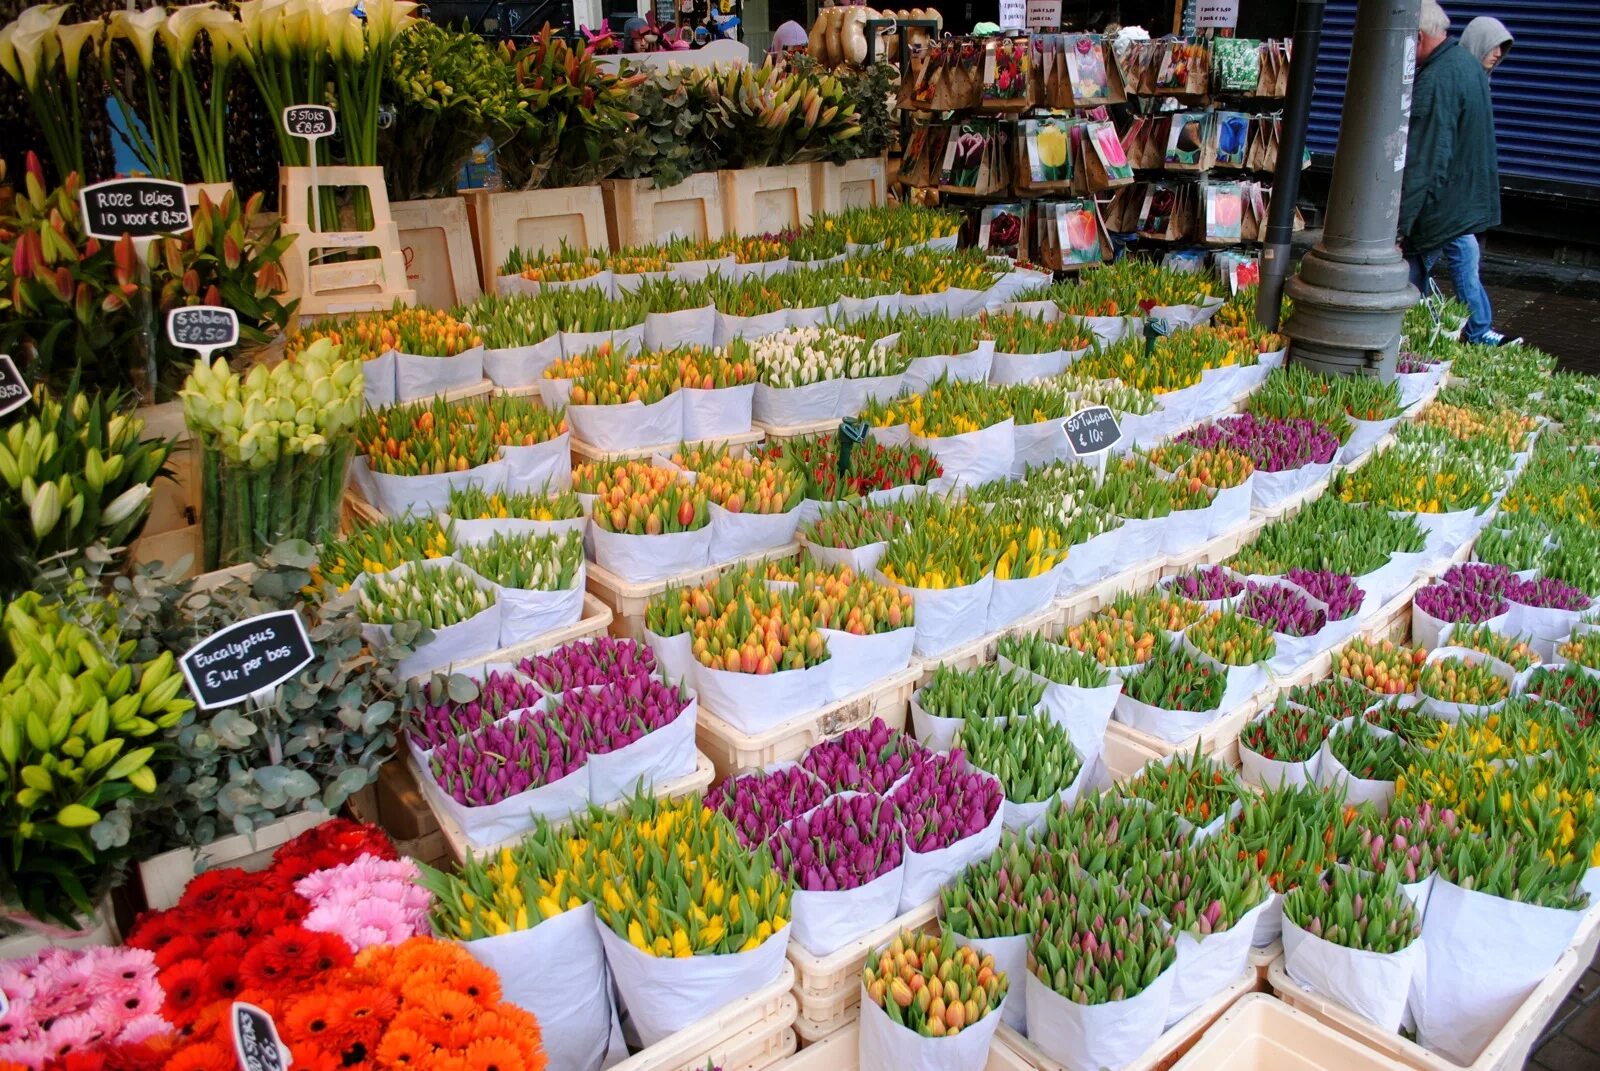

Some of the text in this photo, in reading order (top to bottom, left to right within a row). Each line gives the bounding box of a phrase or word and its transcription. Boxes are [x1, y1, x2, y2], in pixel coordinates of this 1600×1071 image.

[290, 110, 297, 121] 5
[101, 213, 117, 226] 10
[122, 213, 149, 225] voor
[1067, 411, 1112, 433] 50 Tulpen
[193, 627, 276, 669] Eucalyptus
[242, 656, 263, 677] per
